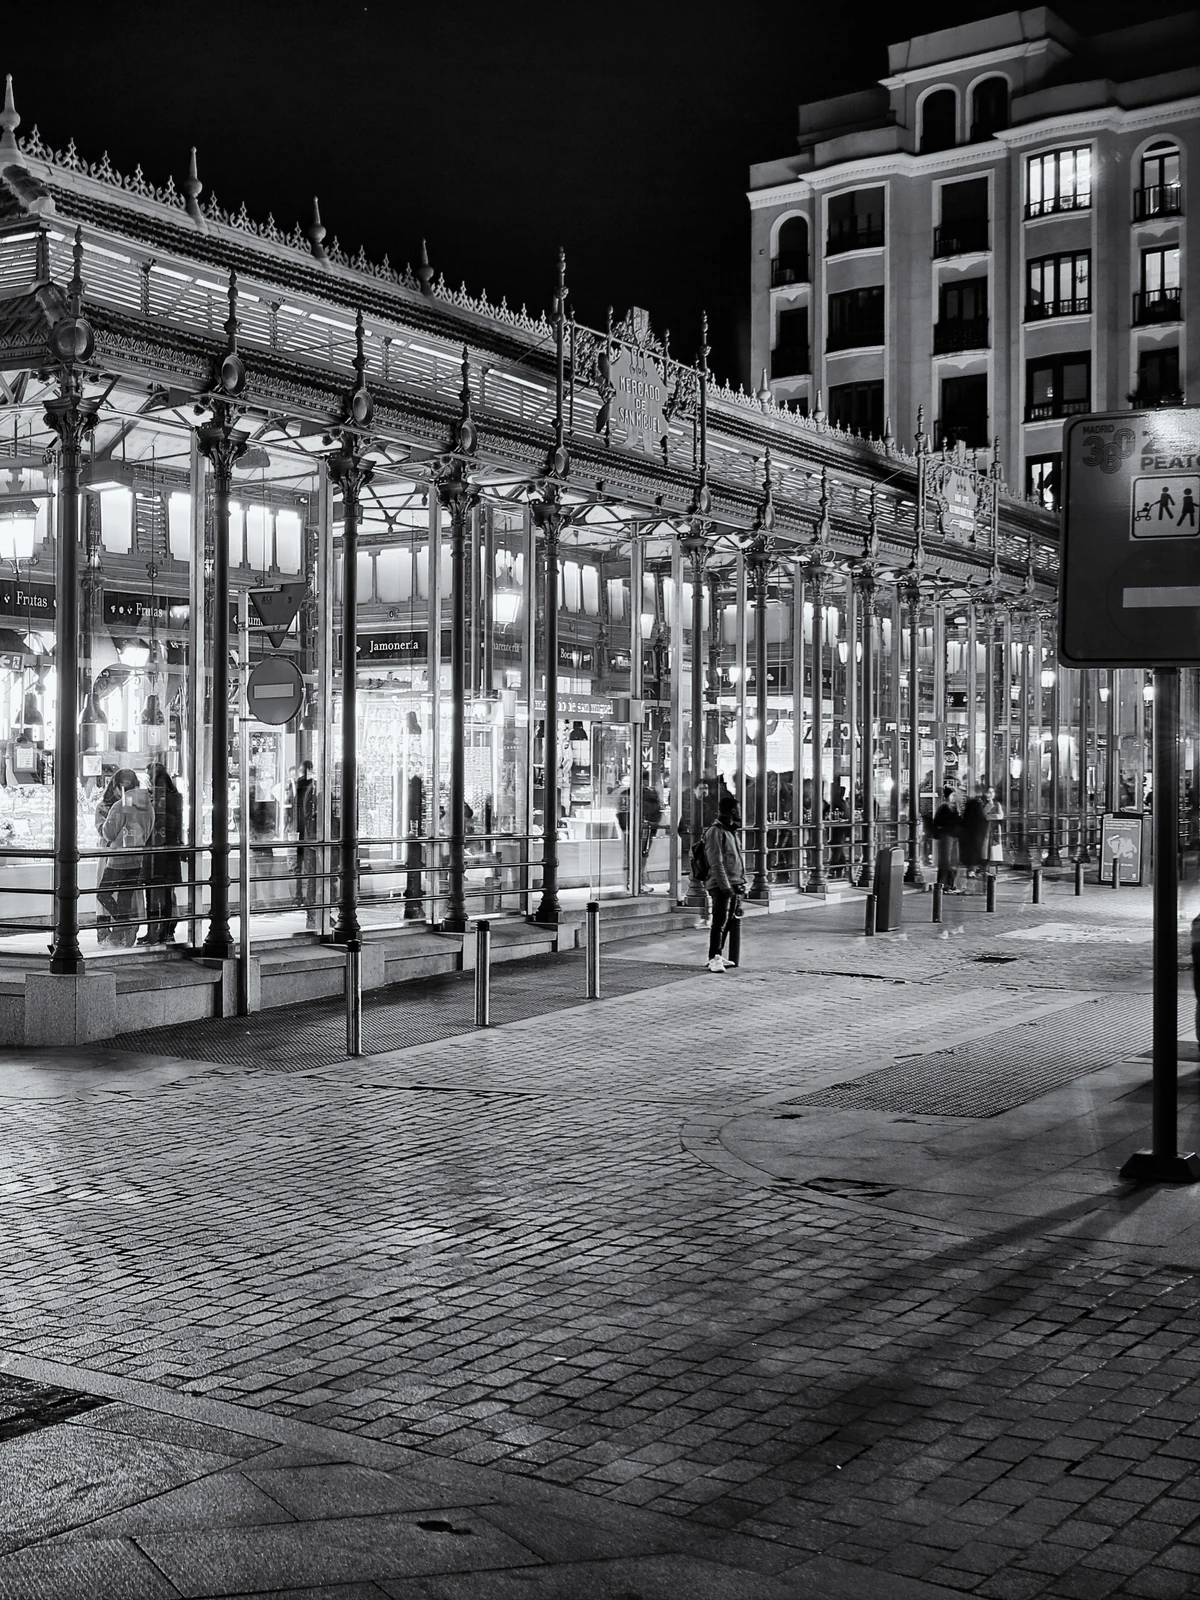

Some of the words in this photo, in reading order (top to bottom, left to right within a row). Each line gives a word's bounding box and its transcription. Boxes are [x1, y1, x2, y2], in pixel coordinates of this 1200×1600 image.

[619, 376, 660, 402] MERCADO
[635, 398, 646, 411] DE
[618, 407, 635, 426] SAN
[1083, 424, 1115, 434] MADRID
[1140, 454, 1200, 471] PEAT
[16, 590, 48, 608] Frutas
[135, 602, 163, 618] Frutas
[369, 639, 419, 653] Jamonería
